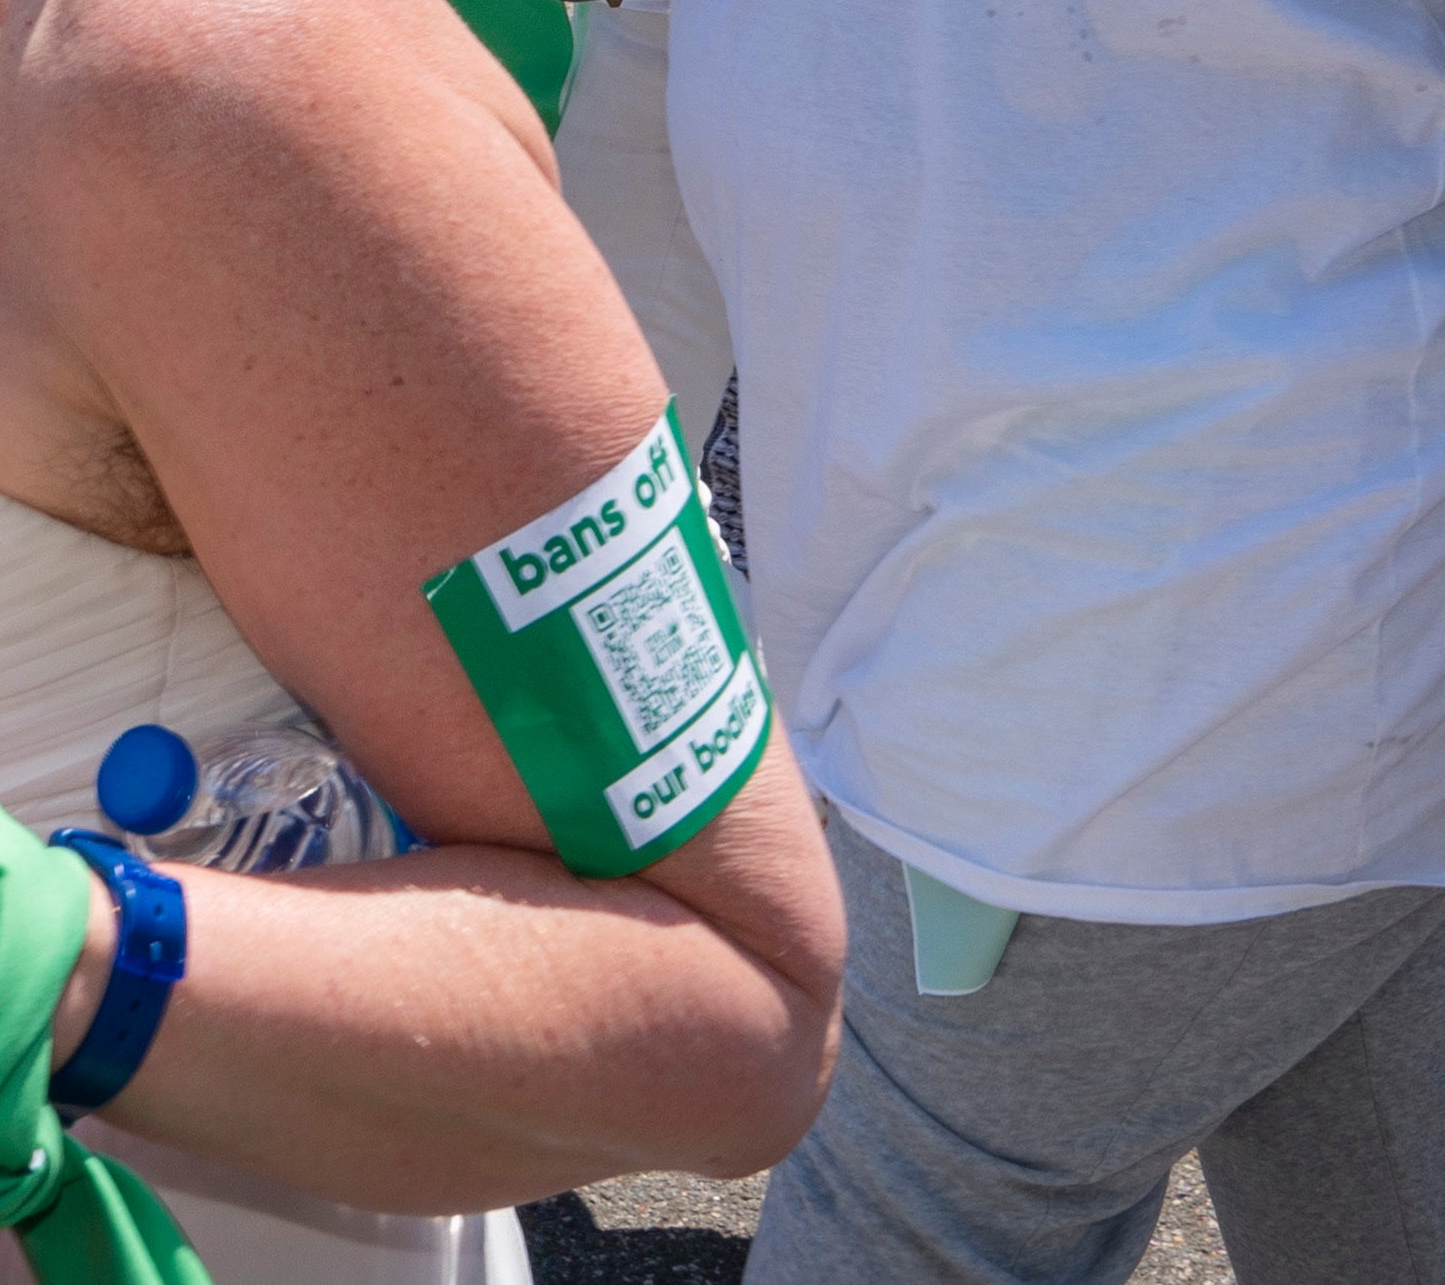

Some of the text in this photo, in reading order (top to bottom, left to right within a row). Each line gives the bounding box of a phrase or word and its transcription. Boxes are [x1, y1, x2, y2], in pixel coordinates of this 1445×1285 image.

[499, 435, 677, 597] bans off
[631, 762, 692, 820] our
